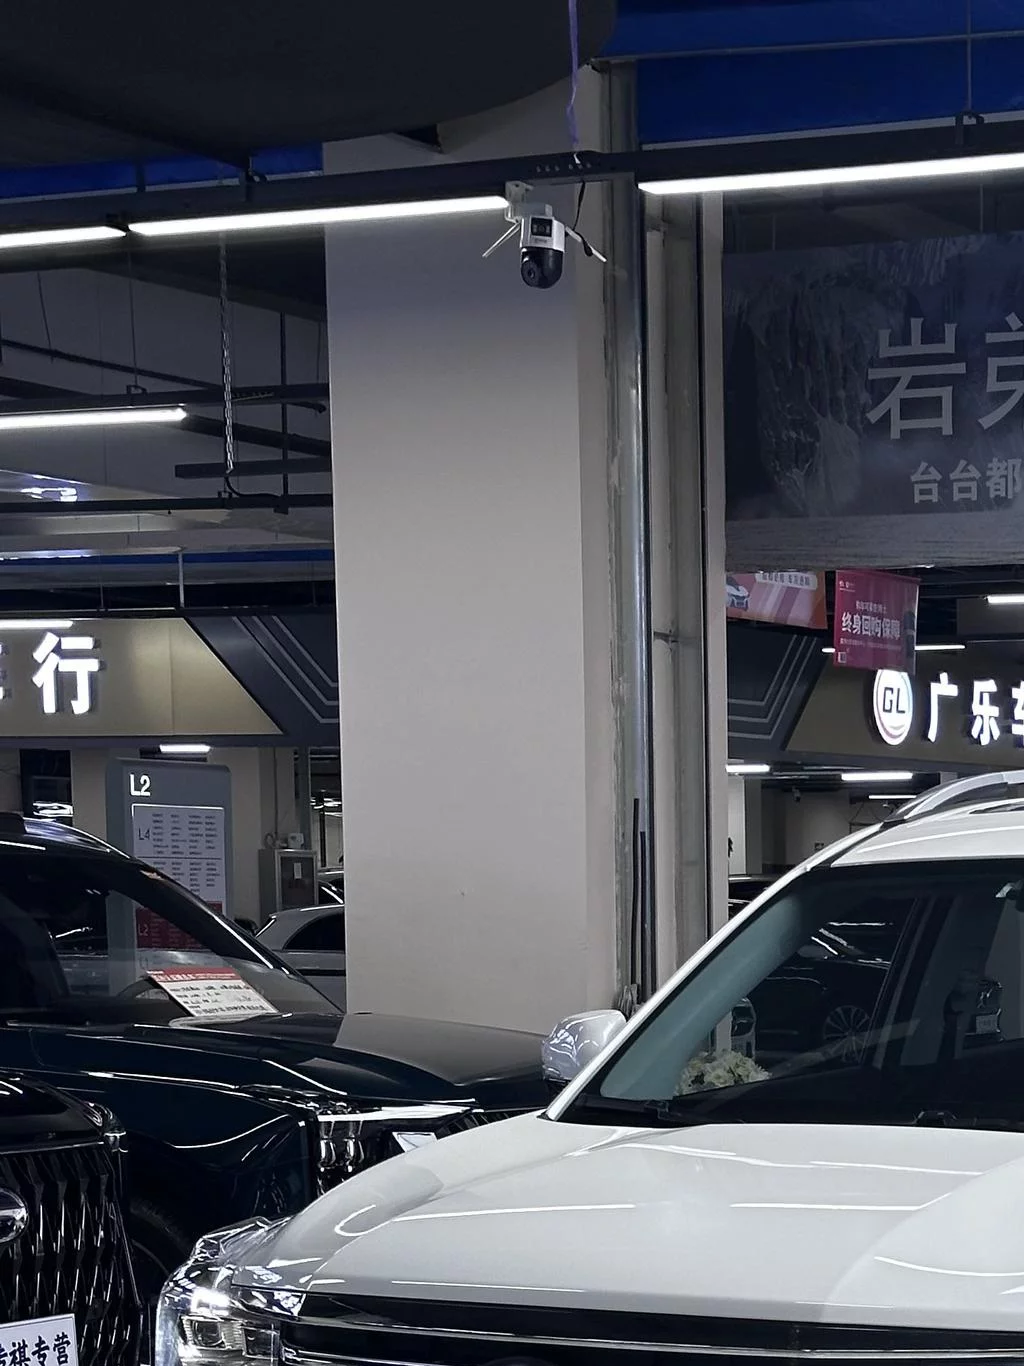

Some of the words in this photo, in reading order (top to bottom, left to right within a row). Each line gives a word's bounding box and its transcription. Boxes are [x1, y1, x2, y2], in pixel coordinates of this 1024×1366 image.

[0, 631, 100, 715] 行
[882, 685, 906, 714] GL
[128, 773, 152, 797] L2
[138, 827, 151, 841] L4
